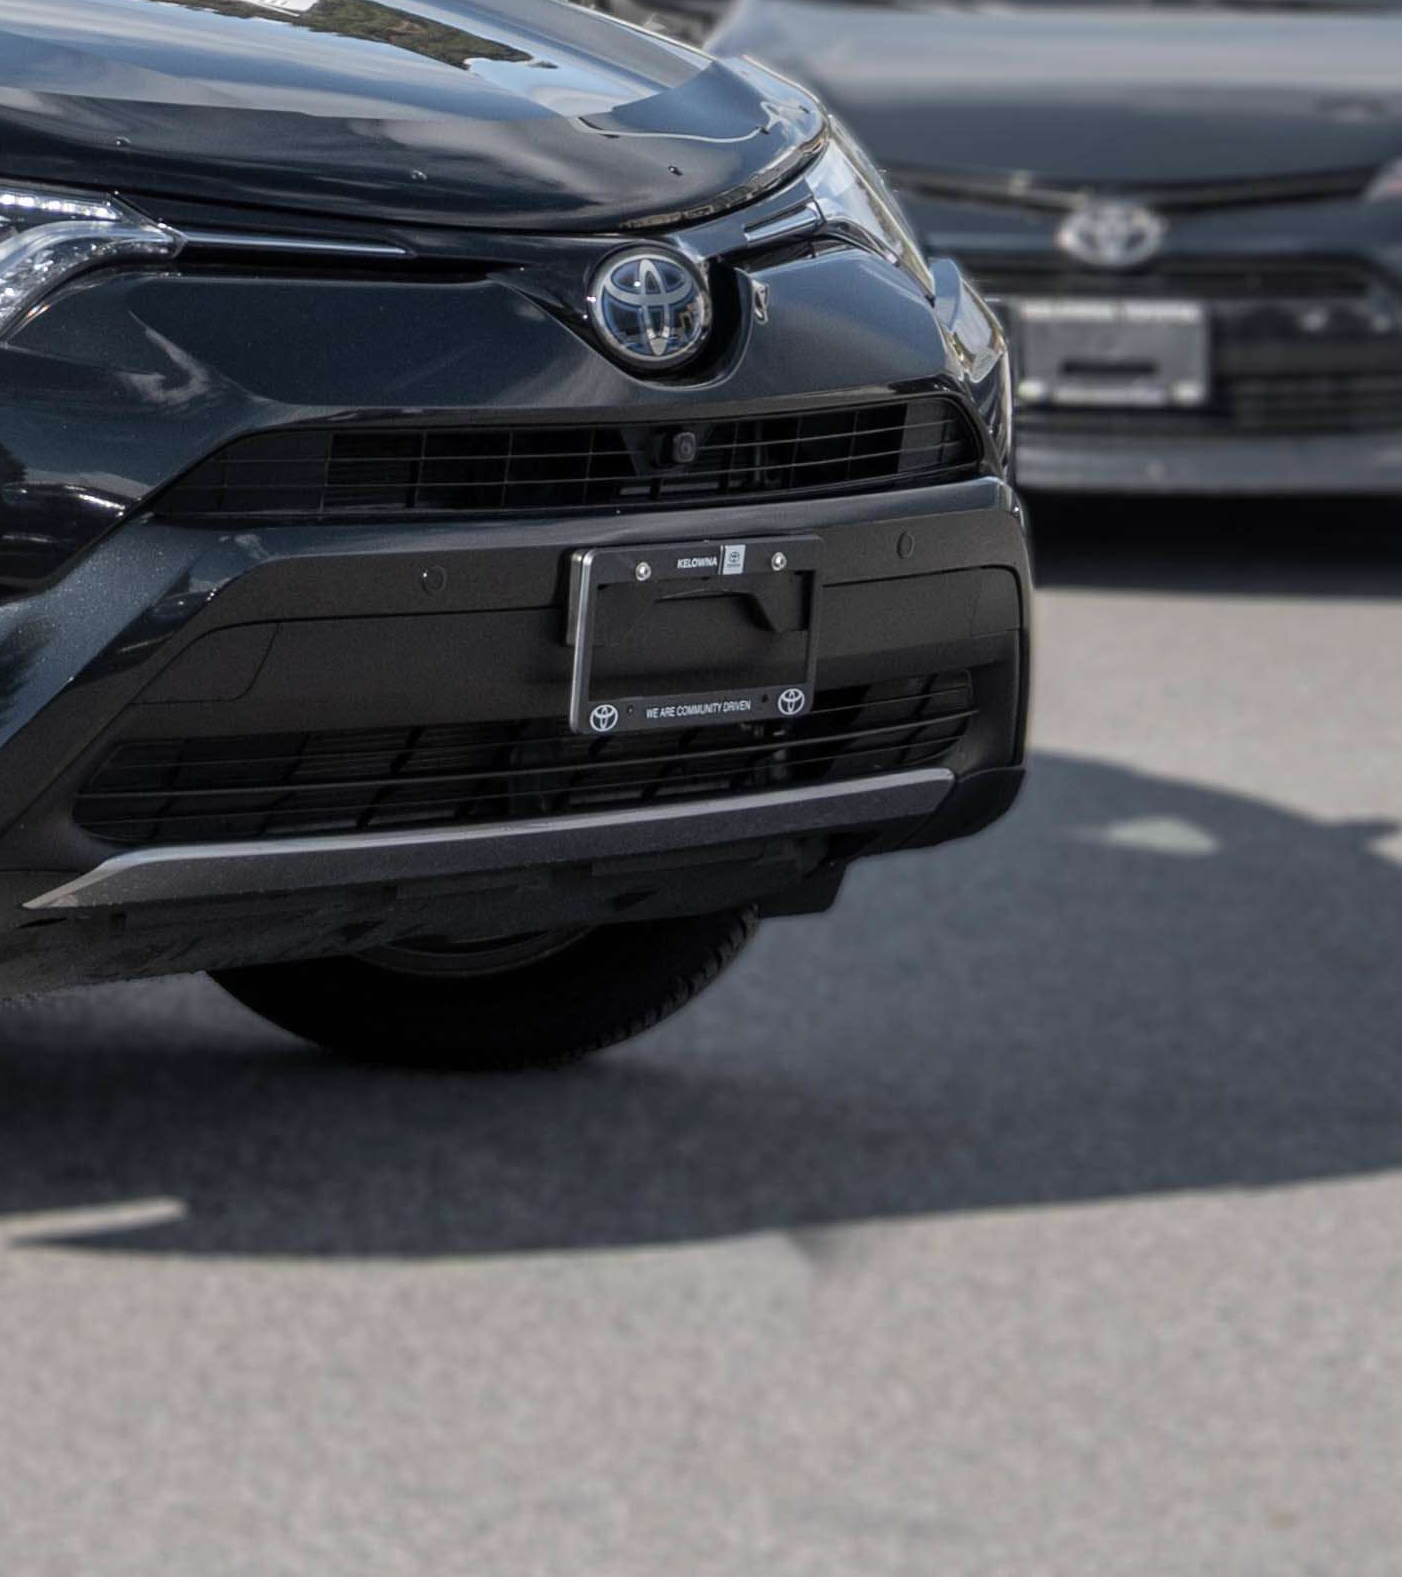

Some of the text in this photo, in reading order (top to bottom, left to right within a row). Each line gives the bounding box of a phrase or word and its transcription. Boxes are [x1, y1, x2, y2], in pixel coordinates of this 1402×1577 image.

[677, 556, 717, 569] KELOWNA
[646, 700, 751, 719] WE ARE COMMUNITY DRIVEN
